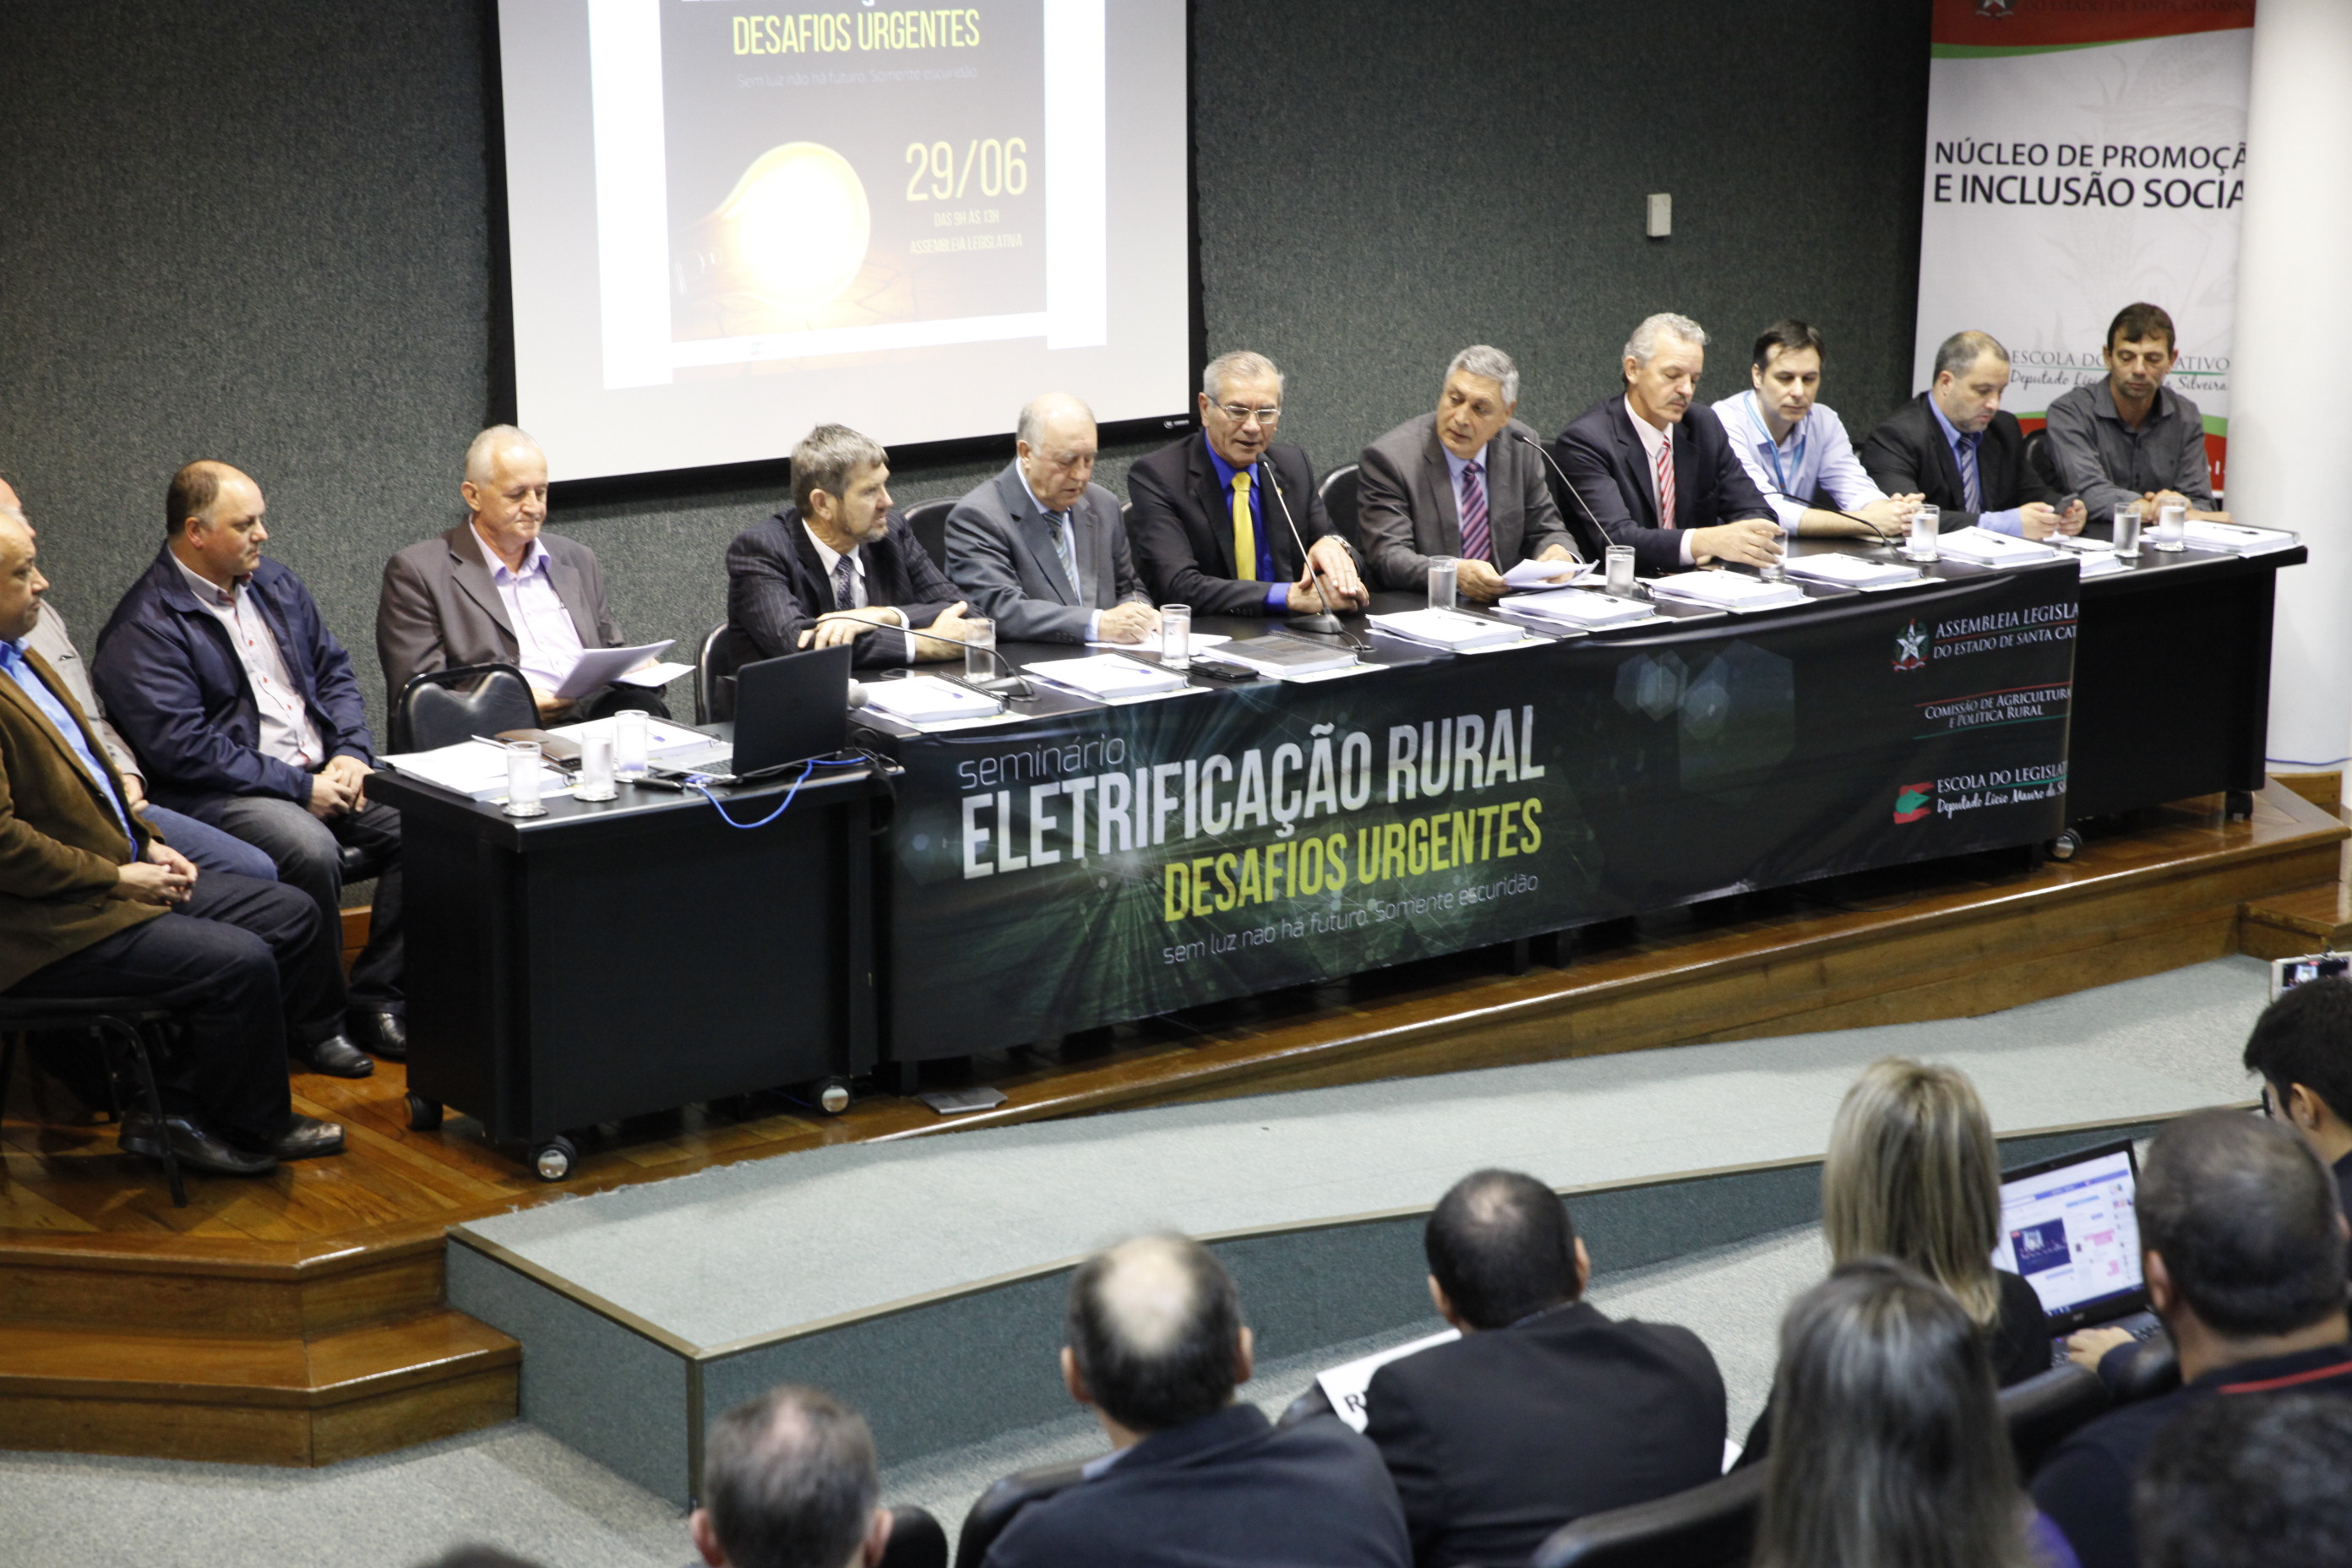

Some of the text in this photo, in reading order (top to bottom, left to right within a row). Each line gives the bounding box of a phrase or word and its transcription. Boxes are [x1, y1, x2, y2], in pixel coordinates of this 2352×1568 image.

[732, 8, 980, 55] DESAFIOS URGENTES
[1935, 138, 2049, 166] NÚCLEO
[2057, 144, 2094, 167] DE
[906, 136, 1027, 202] 29/06
[1934, 174, 1952, 203] E
[1961, 172, 2135, 208] INCLUSÃO
[2012, 350, 2076, 367] ESCOLA
[2010, 369, 2070, 391] Deputado
[1935, 611, 2020, 640] ASSEMBLEIA
[1933, 645, 1952, 660] DO
[1954, 637, 1997, 656] ESTADO
[2000, 634, 2014, 649] DE
[2016, 629, 2053, 645] SANTA
[1980, 697, 1995, 710] DE
[2006, 705, 2044, 720] RURAL
[959, 733, 1125, 789] seminário
[961, 705, 1546, 879] ELETRIFICAÇÃO RURAL
[1937, 774, 1987, 793] ESCOLA
[1990, 770, 2012, 786] DO
[1164, 798, 1544, 923] DESAFIOS URGENTES
[1211, 933, 1237, 955] luz
[1281, 917, 1304, 939] há
[1458, 873, 1539, 906] escuridão
